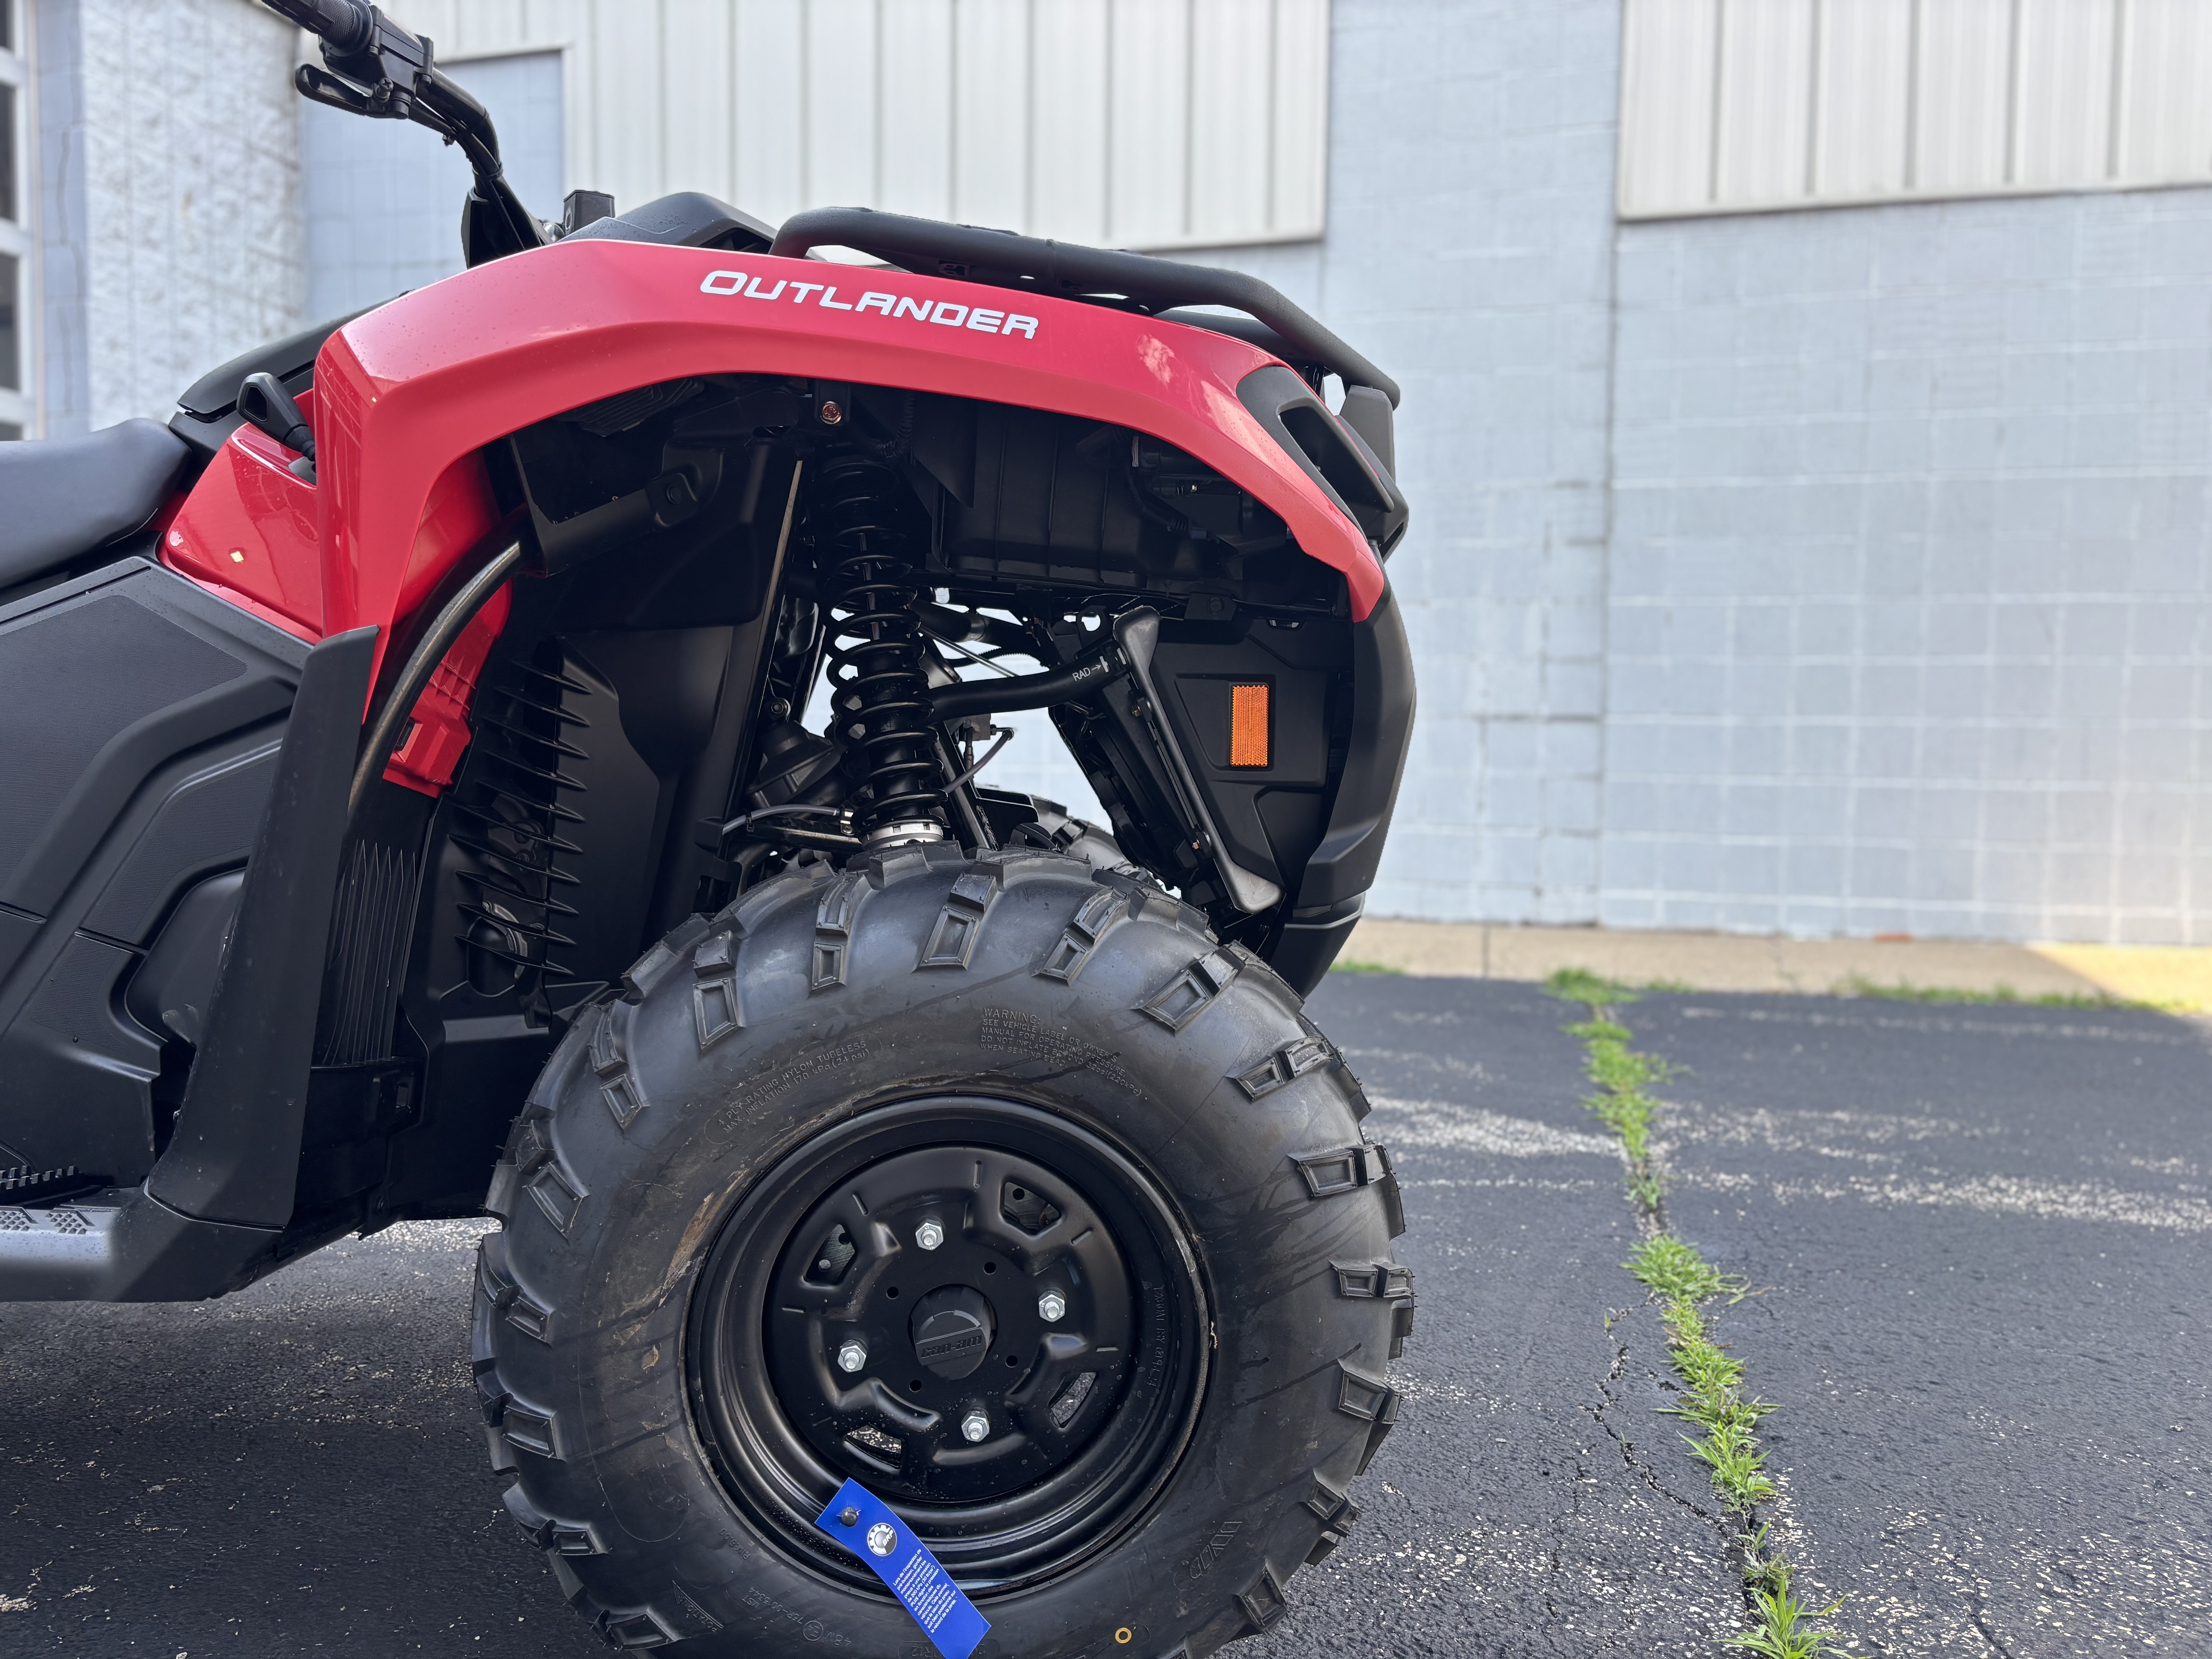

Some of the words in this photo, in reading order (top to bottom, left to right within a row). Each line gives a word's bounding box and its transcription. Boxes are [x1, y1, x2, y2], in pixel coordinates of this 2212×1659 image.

[700, 270, 1039, 339] OUTLANDER
[1072, 667, 1091, 682] RAD
[984, 1008, 1041, 1025] WARNING:
[982, 1027, 1014, 1037] MANUAL
[1019, 1032, 1035, 1041] FOR
[1039, 1037, 1083, 1055] OPERATING
[1085, 1052, 1125, 1077] PRESSURE.
[1003, 1021, 1037, 1033] VEHICLE
[1041, 1028, 1064, 1040] LABEL
[1069, 1037, 1080, 1046] OR
[1084, 1042, 1117, 1062] OWNER'S
[1017, 1039, 1049, 1053] INFLATE
[1007, 1046, 1041, 1059] SEATING
[726, 1102, 742, 1119] PLY
[745, 1079, 778, 1103] RATING
[781, 1060, 813, 1081] NYLON
[817, 1041, 866, 1063] TUBELESS
[723, 1116, 745, 1133] MAX.
[745, 1082, 790, 1115] INFLATION
[793, 1073, 809, 1084] 170
[921, 1335, 982, 1358] can-am
[883, 1530, 893, 1546] BRP
[903, 1554, 918, 1573] l'inspection
[904, 1587, 913, 1599] pneus
[920, 1563, 931, 1578] pression
[910, 1596, 919, 1607] PUIS
[928, 1568, 939, 1584] pression
[917, 1592, 929, 1606] fonction
[934, 1616, 943, 1630] rebord
